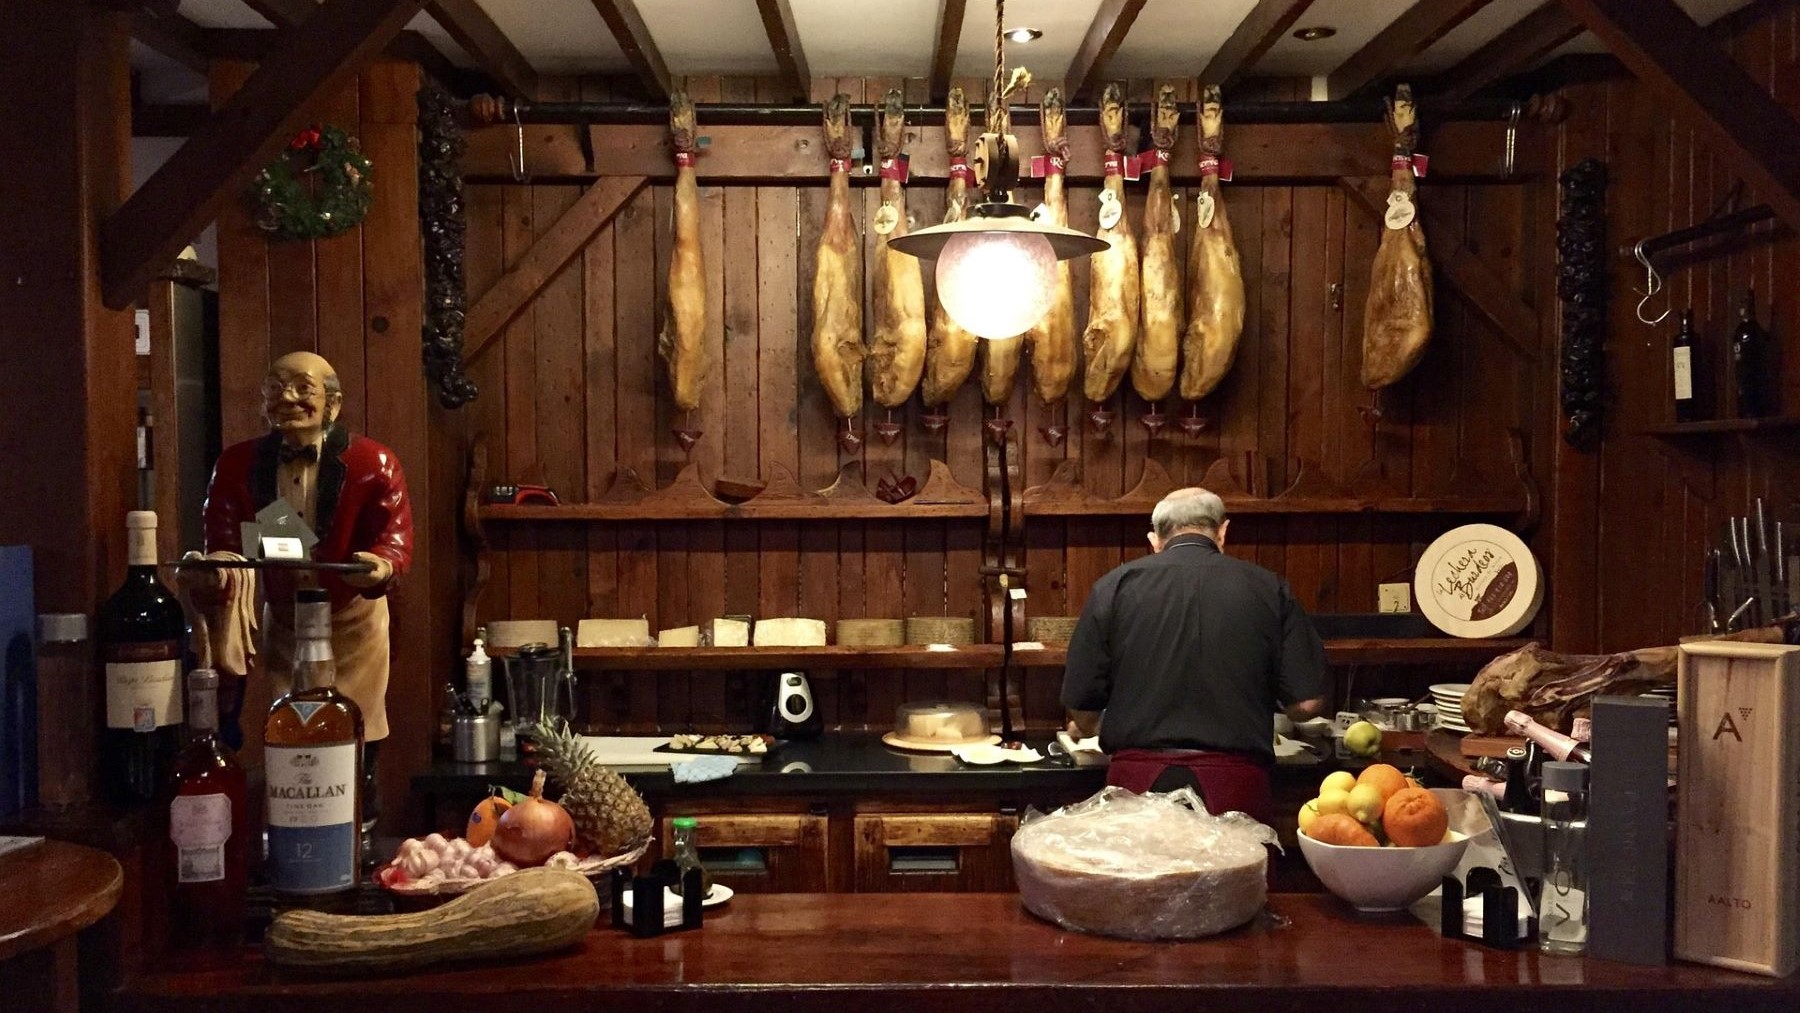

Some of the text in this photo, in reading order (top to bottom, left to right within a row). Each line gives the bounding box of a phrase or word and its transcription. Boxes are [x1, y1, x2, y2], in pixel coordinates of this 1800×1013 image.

[1712, 712, 1743, 742] A
[269, 784, 347, 798] MACALLAN
[296, 843, 313, 859] 12
[1708, 894, 1752, 910] AALTO
